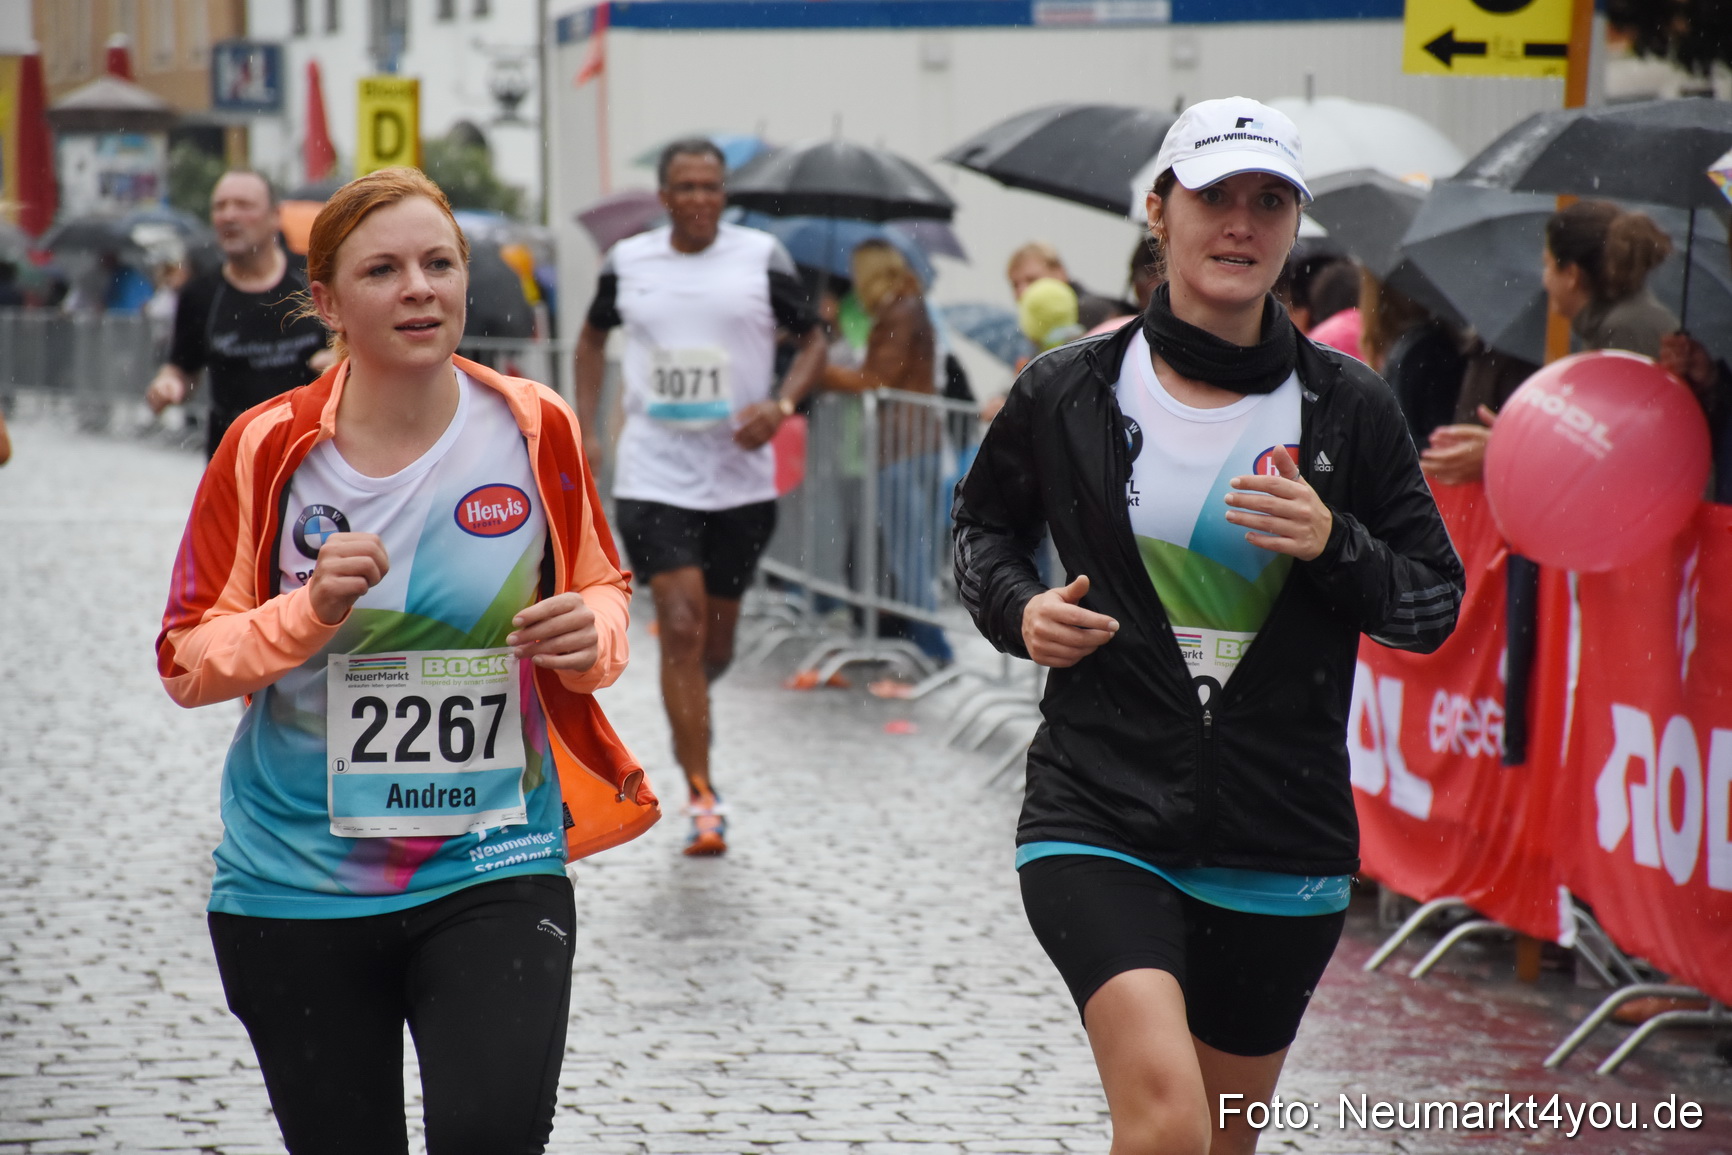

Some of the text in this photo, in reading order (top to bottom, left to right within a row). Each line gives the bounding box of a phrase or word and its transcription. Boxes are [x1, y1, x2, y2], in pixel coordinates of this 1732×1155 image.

[373, 110, 406, 161] D
[466, 497, 524, 523] Hervis
[345, 671, 409, 682] NeuerMarkt
[421, 653, 510, 678] BOCK
[351, 693, 507, 763] 2267
[386, 783, 476, 809] Andrea
[469, 831, 557, 862] Neumarkter
